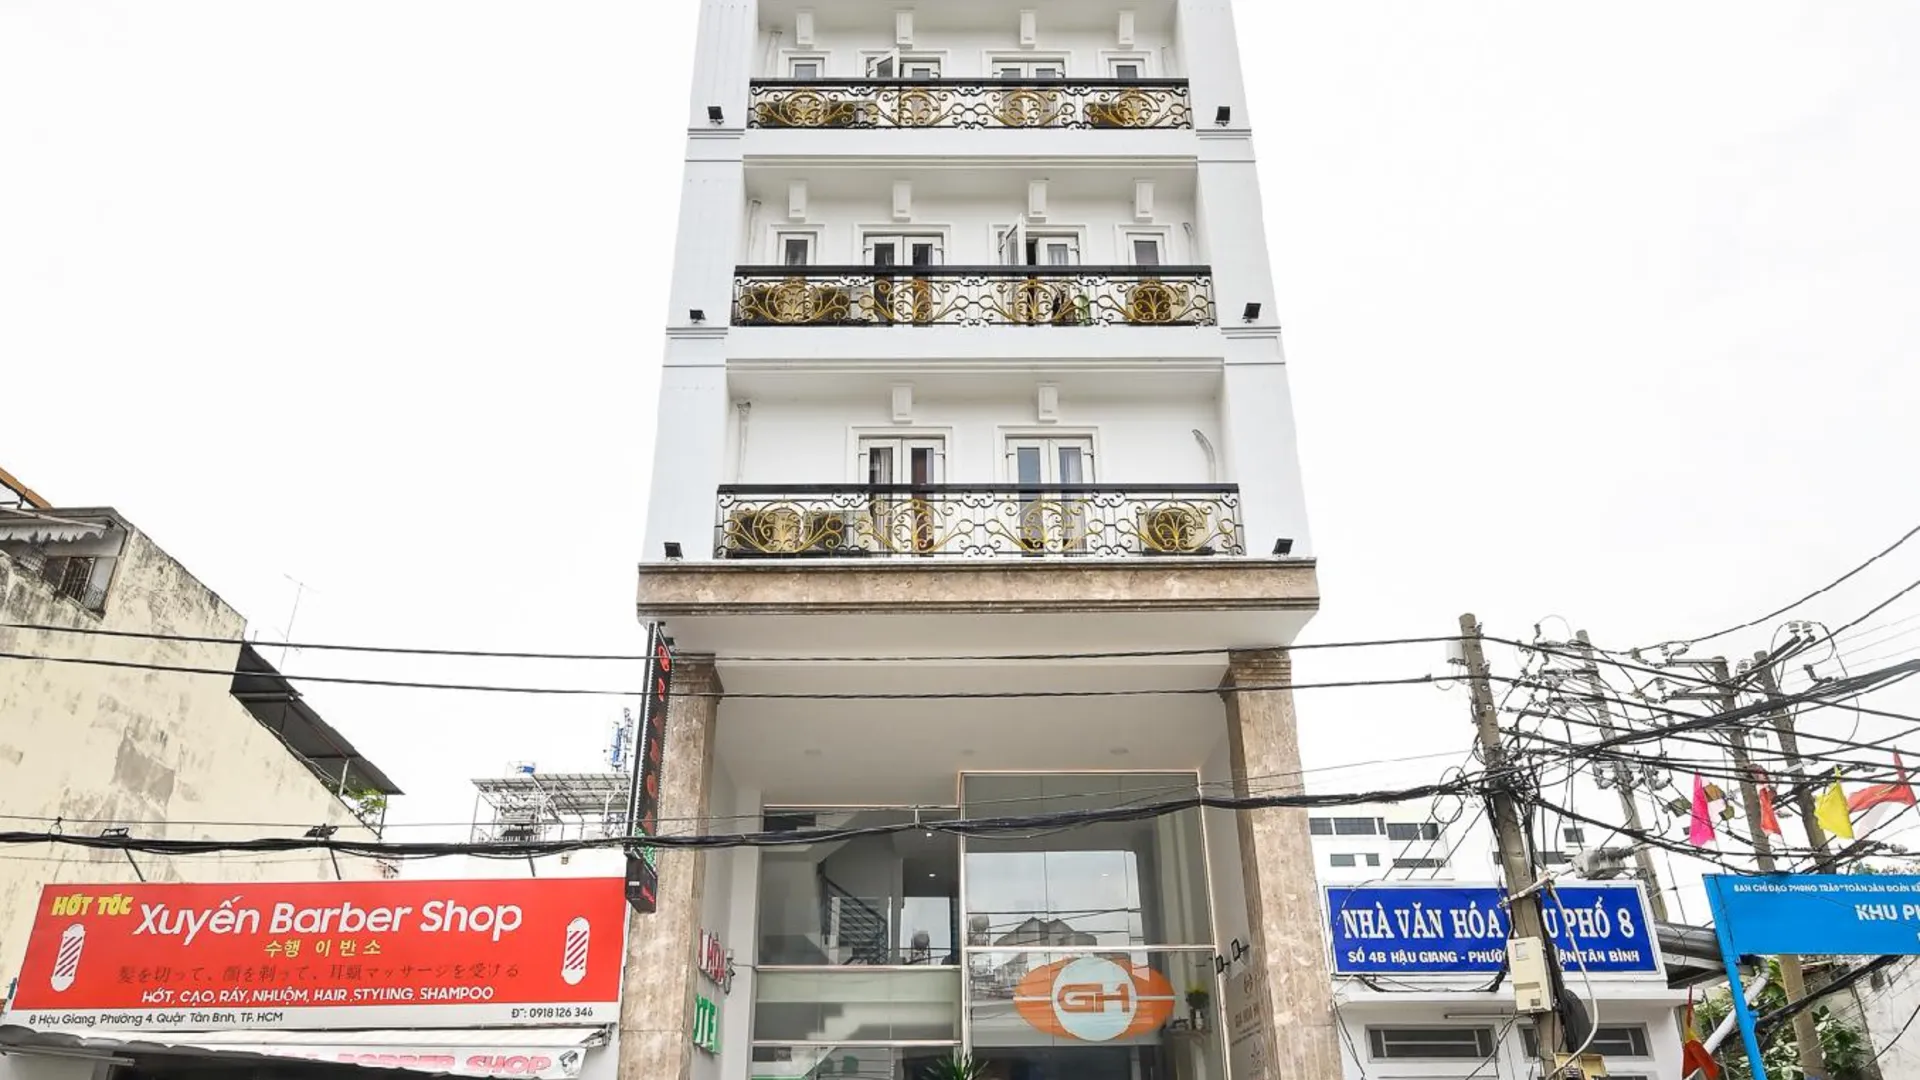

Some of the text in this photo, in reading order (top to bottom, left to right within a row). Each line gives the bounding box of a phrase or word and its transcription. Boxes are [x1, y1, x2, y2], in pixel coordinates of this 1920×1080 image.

[132, 895, 522, 946] Xuyến Barber Shop
[1341, 901, 1395, 939] NHÀ
[1394, 902, 1445, 939] VĂN
[1450, 900, 1504, 939] HÓA
[1564, 896, 1611, 939] PHỐ
[1617, 908, 1635, 939] 8
[1854, 904, 1898, 920] KHU
[1348, 946, 1366, 963] SỐ
[1368, 951, 1387, 963] 4B
[1391, 949, 1417, 966] HẬU
[1419, 951, 1459, 964] GIANG
[1608, 947, 1641, 962] BÌNH
[420, 986, 494, 1000] SHAMPOO
[1057, 982, 1131, 1014] GH
[257, 1012, 283, 1023] HCM
[529, 1008, 554, 1018] 0918
[555, 1007, 572, 1018] 126
[574, 1007, 593, 1017] 346
